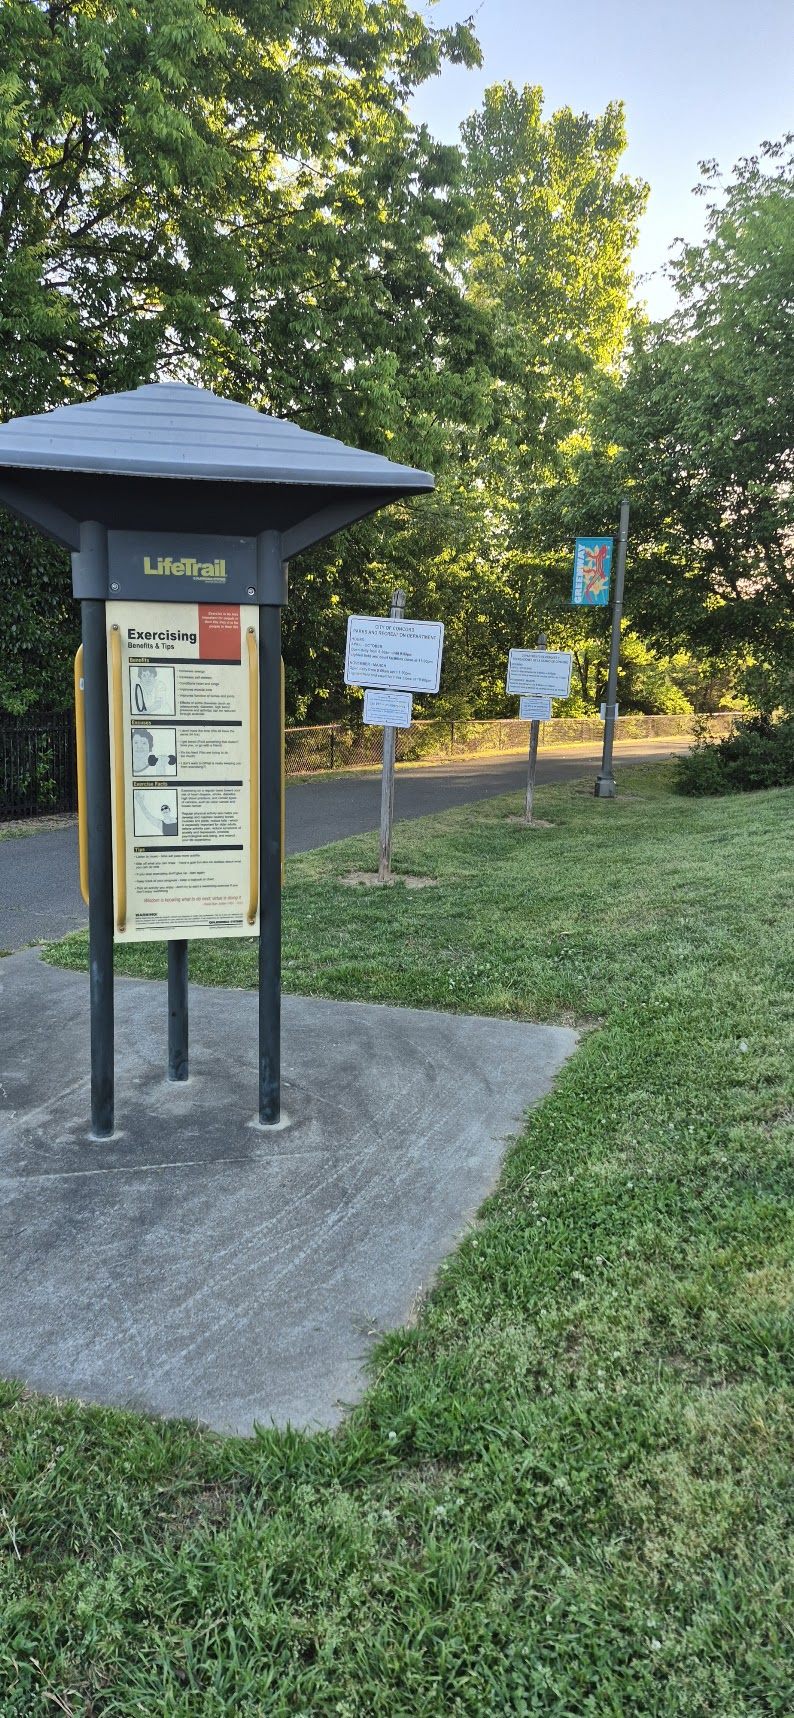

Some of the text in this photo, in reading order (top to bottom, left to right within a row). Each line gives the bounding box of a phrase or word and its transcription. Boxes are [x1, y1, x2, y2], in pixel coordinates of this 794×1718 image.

[143, 556, 226, 577] LifeTrail
[127, 628, 197, 644] Exercising
[127, 641, 153, 649] Benefits
[161, 643, 175, 651] Tips
